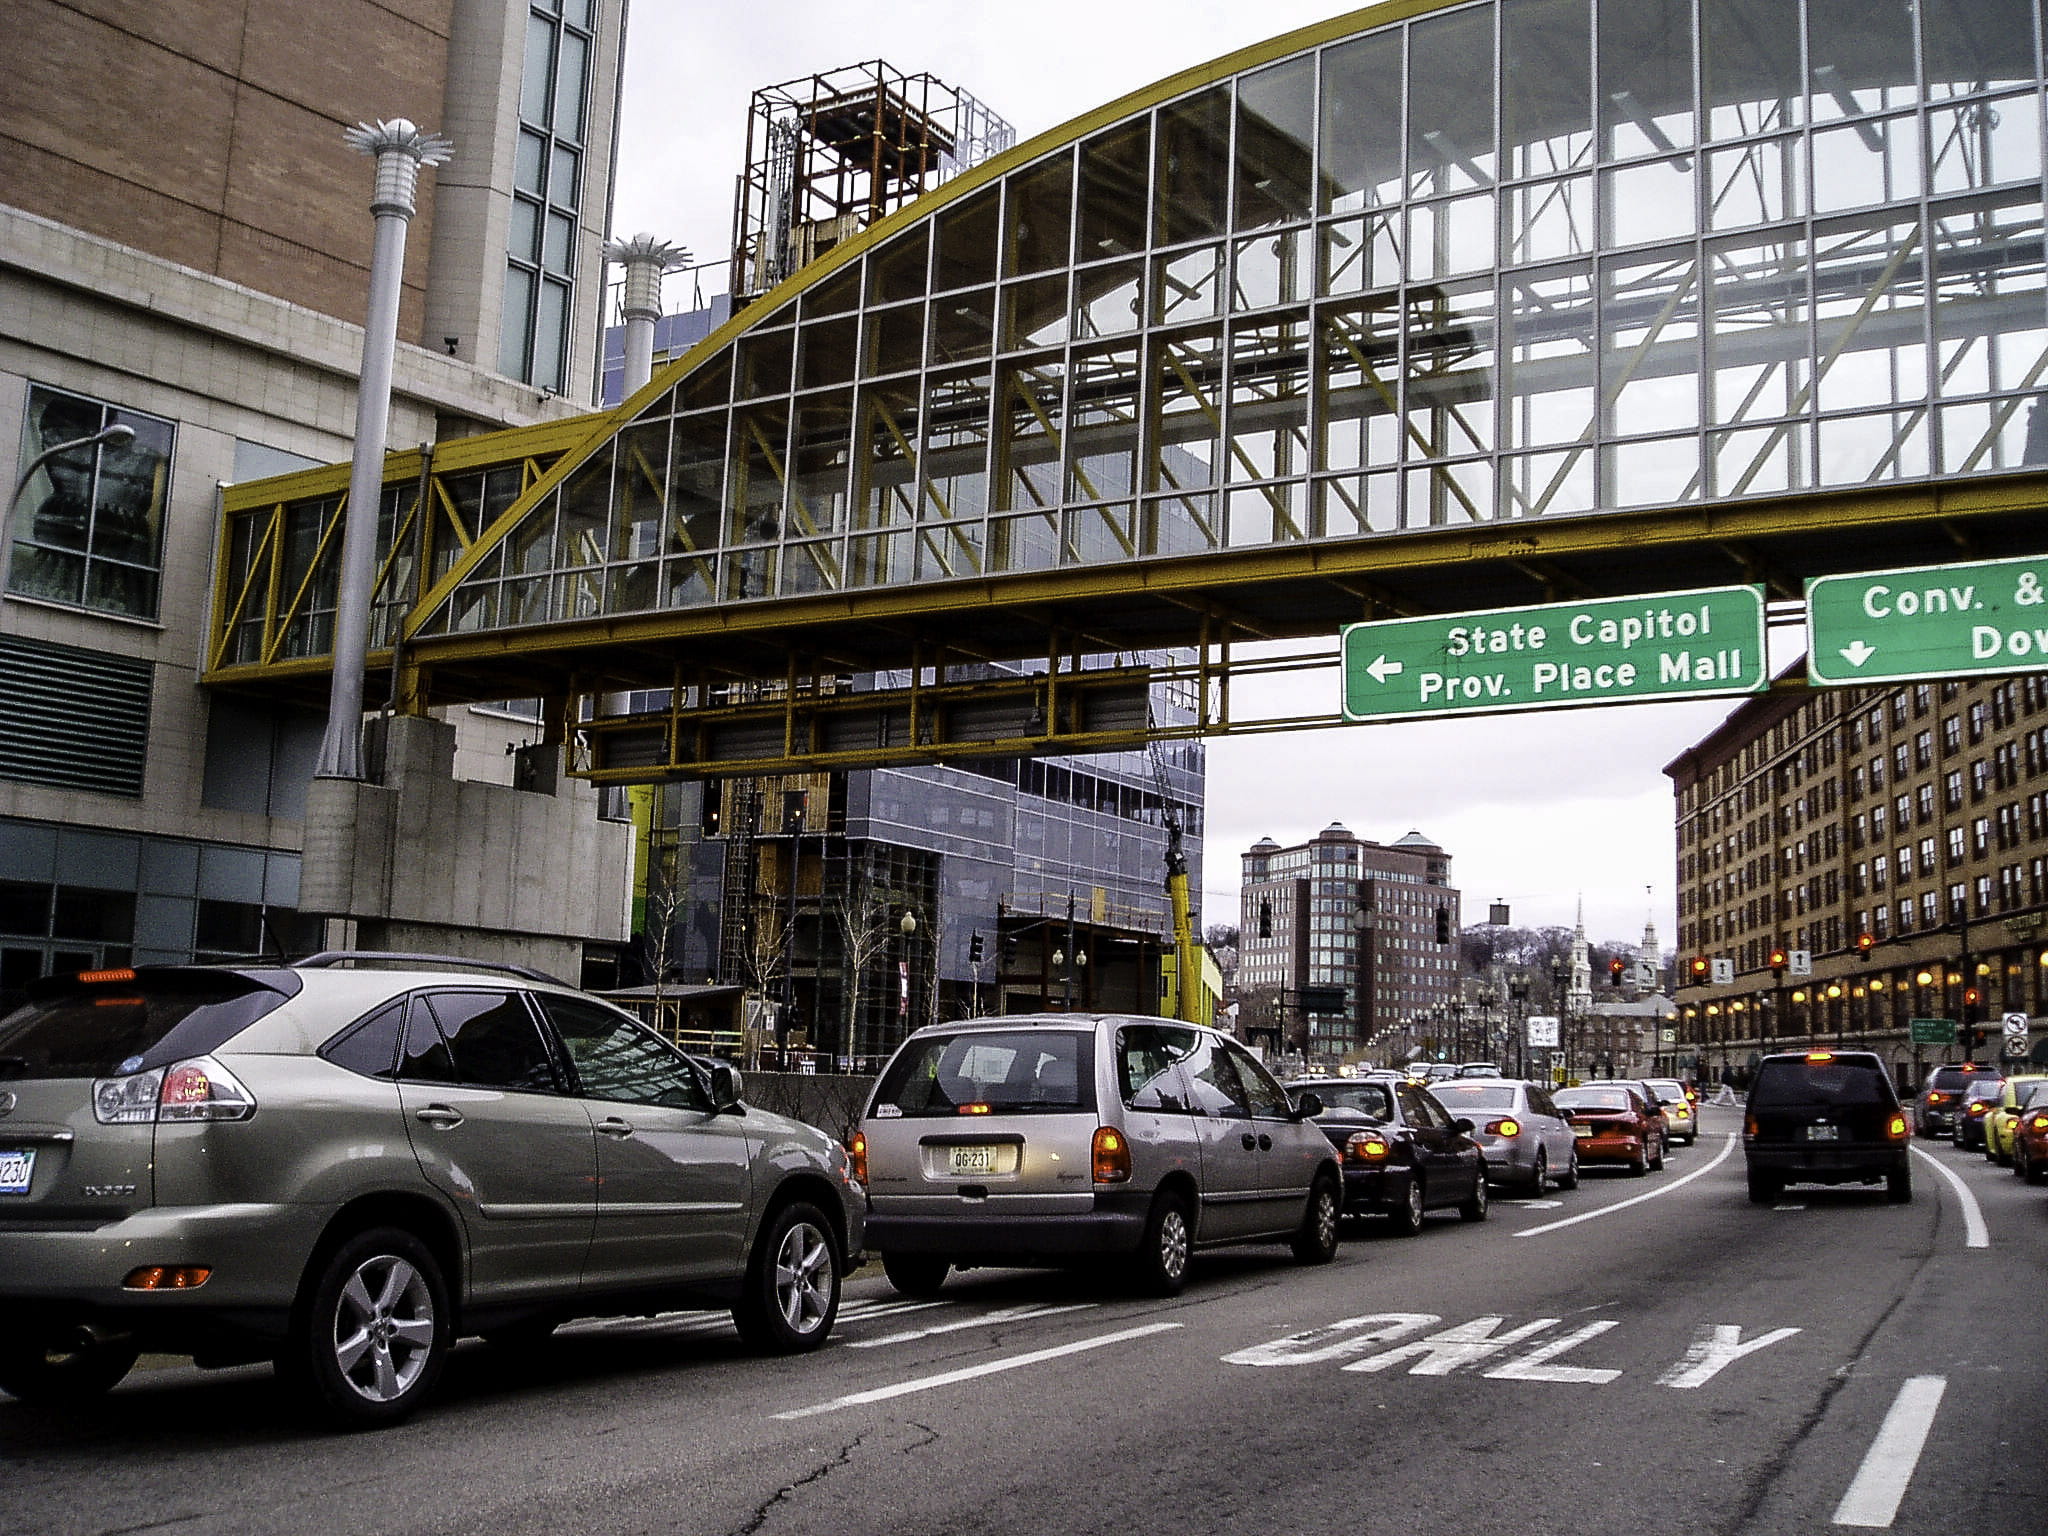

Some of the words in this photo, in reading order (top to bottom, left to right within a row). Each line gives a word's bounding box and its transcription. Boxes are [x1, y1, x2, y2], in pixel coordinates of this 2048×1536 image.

[1863, 586, 1983, 619] Conv.
[2015, 572, 2045, 606] &
[1447, 624, 1545, 656] State
[1570, 605, 1710, 648] Capitol
[1421, 673, 1511, 703] Prov.
[1534, 663, 1636, 693] Place
[1660, 649, 1741, 684] Mall
[1220, 1312, 1802, 1388] ONLY
